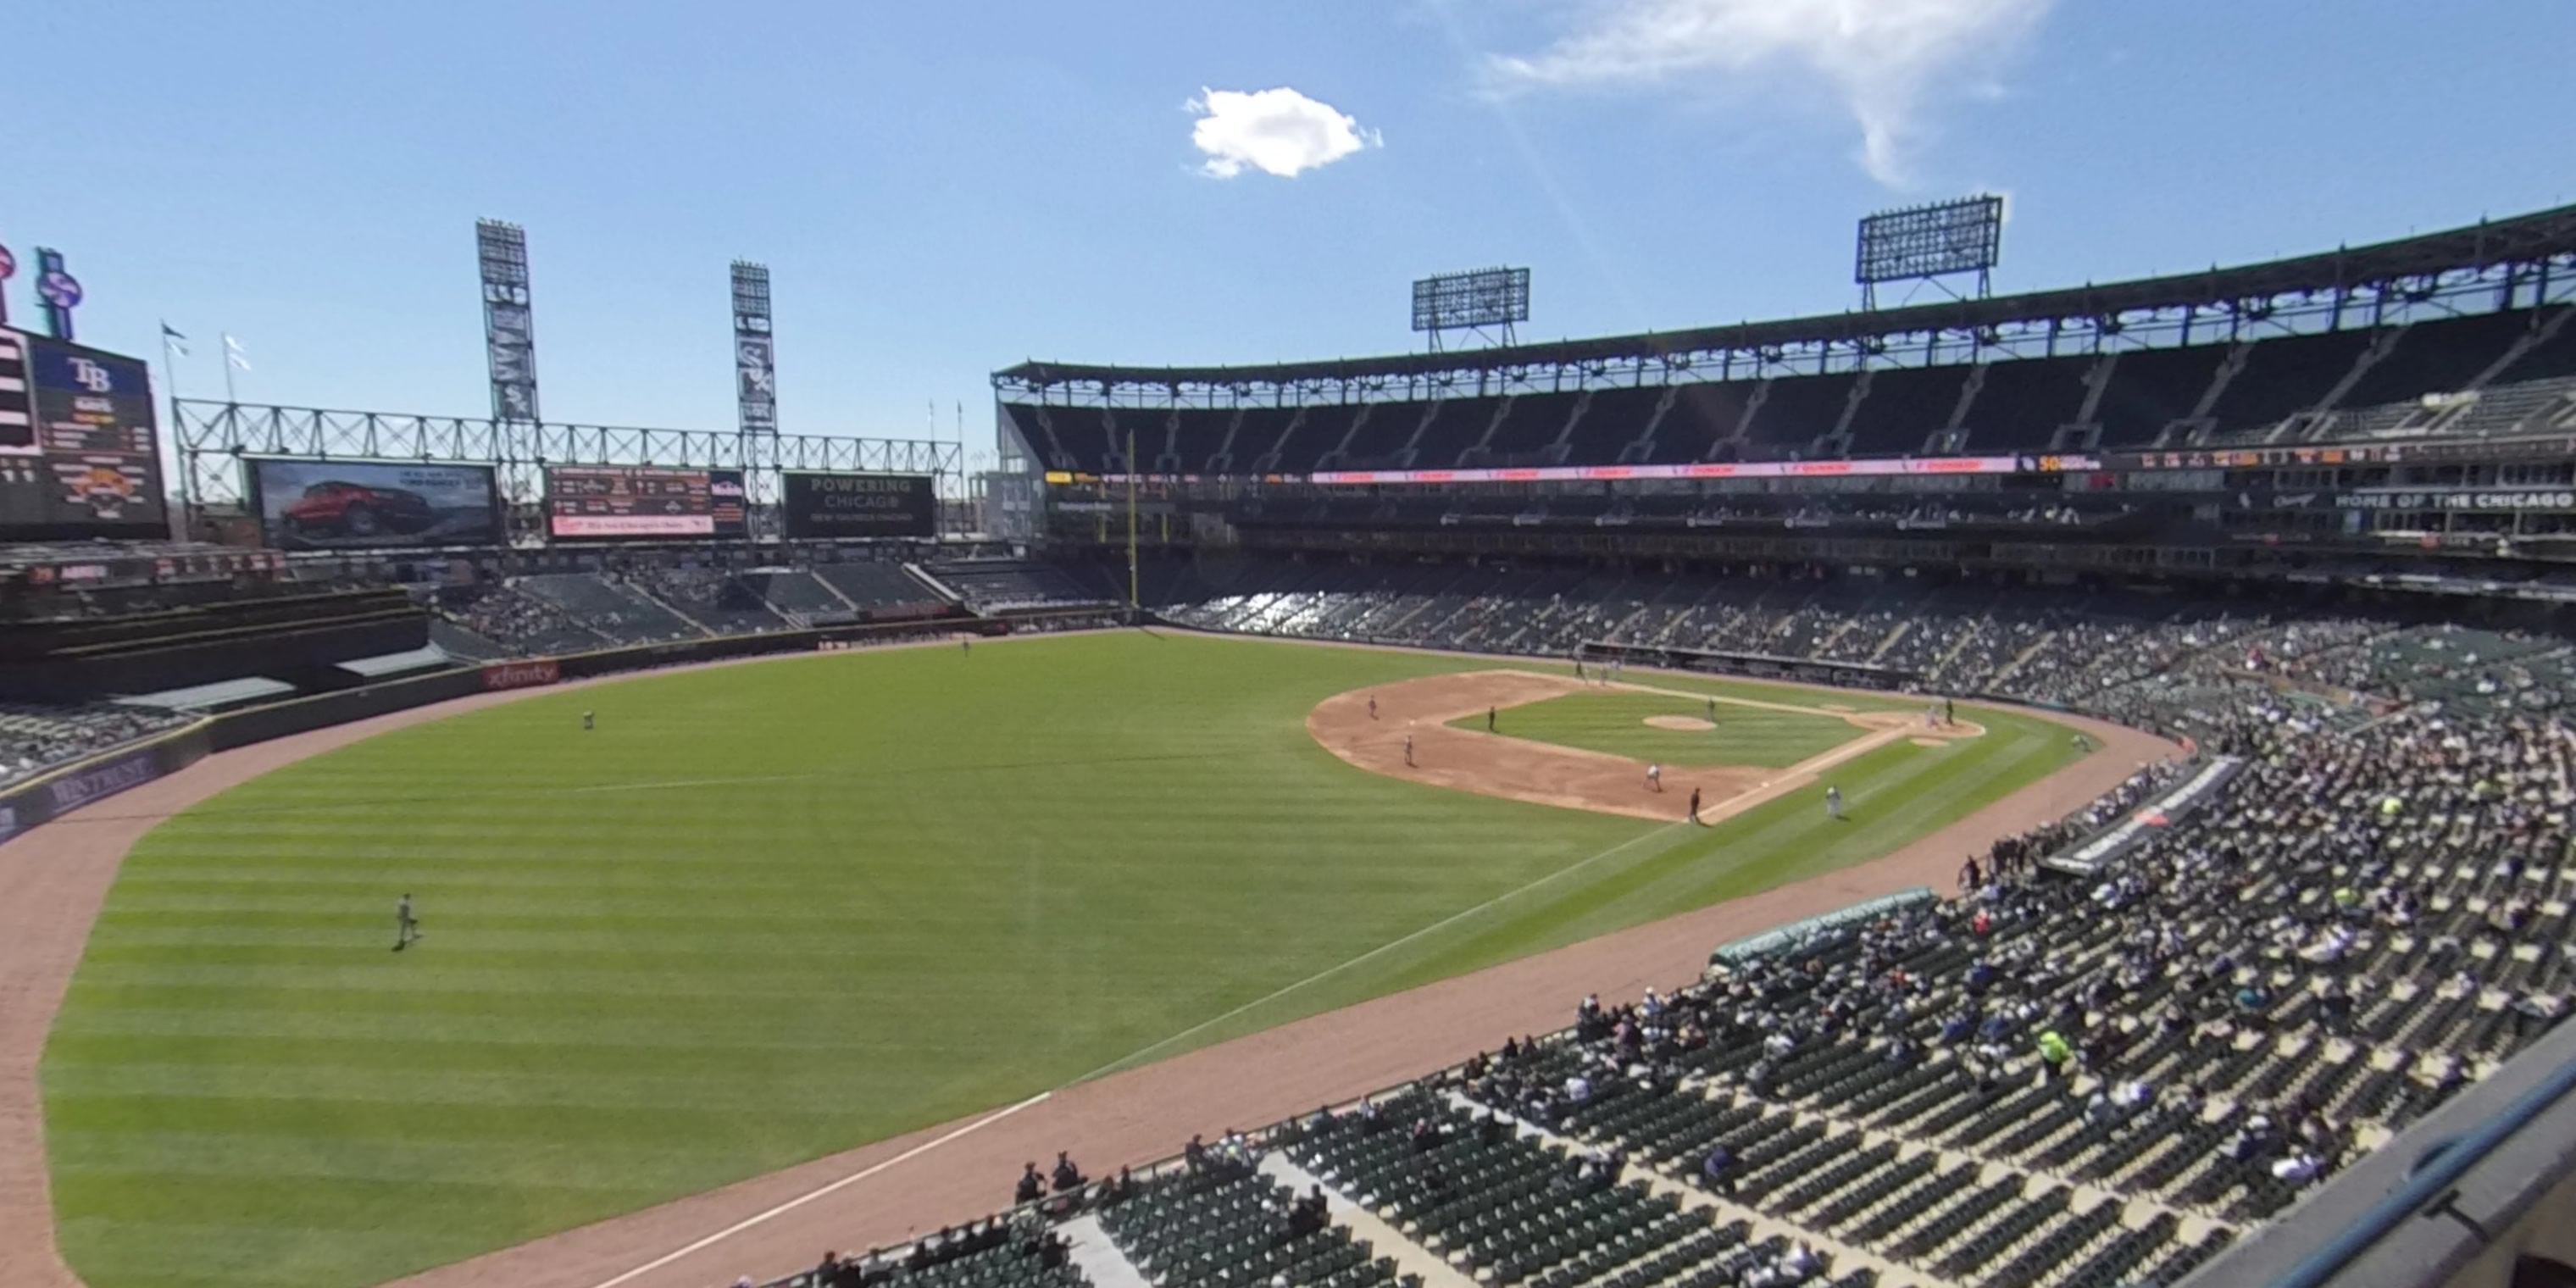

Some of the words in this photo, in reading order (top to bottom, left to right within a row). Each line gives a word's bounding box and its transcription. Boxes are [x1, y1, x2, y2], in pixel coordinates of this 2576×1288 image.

[68, 357, 111, 392] TB
[811, 478, 911, 492] POWERING
[2335, 494, 2390, 508] HOME
[2396, 494, 2426, 508] OF
[2432, 493, 2470, 508] THE
[2475, 492, 2573, 508] CHICAGO
[489, 666, 554, 686] xfinity
